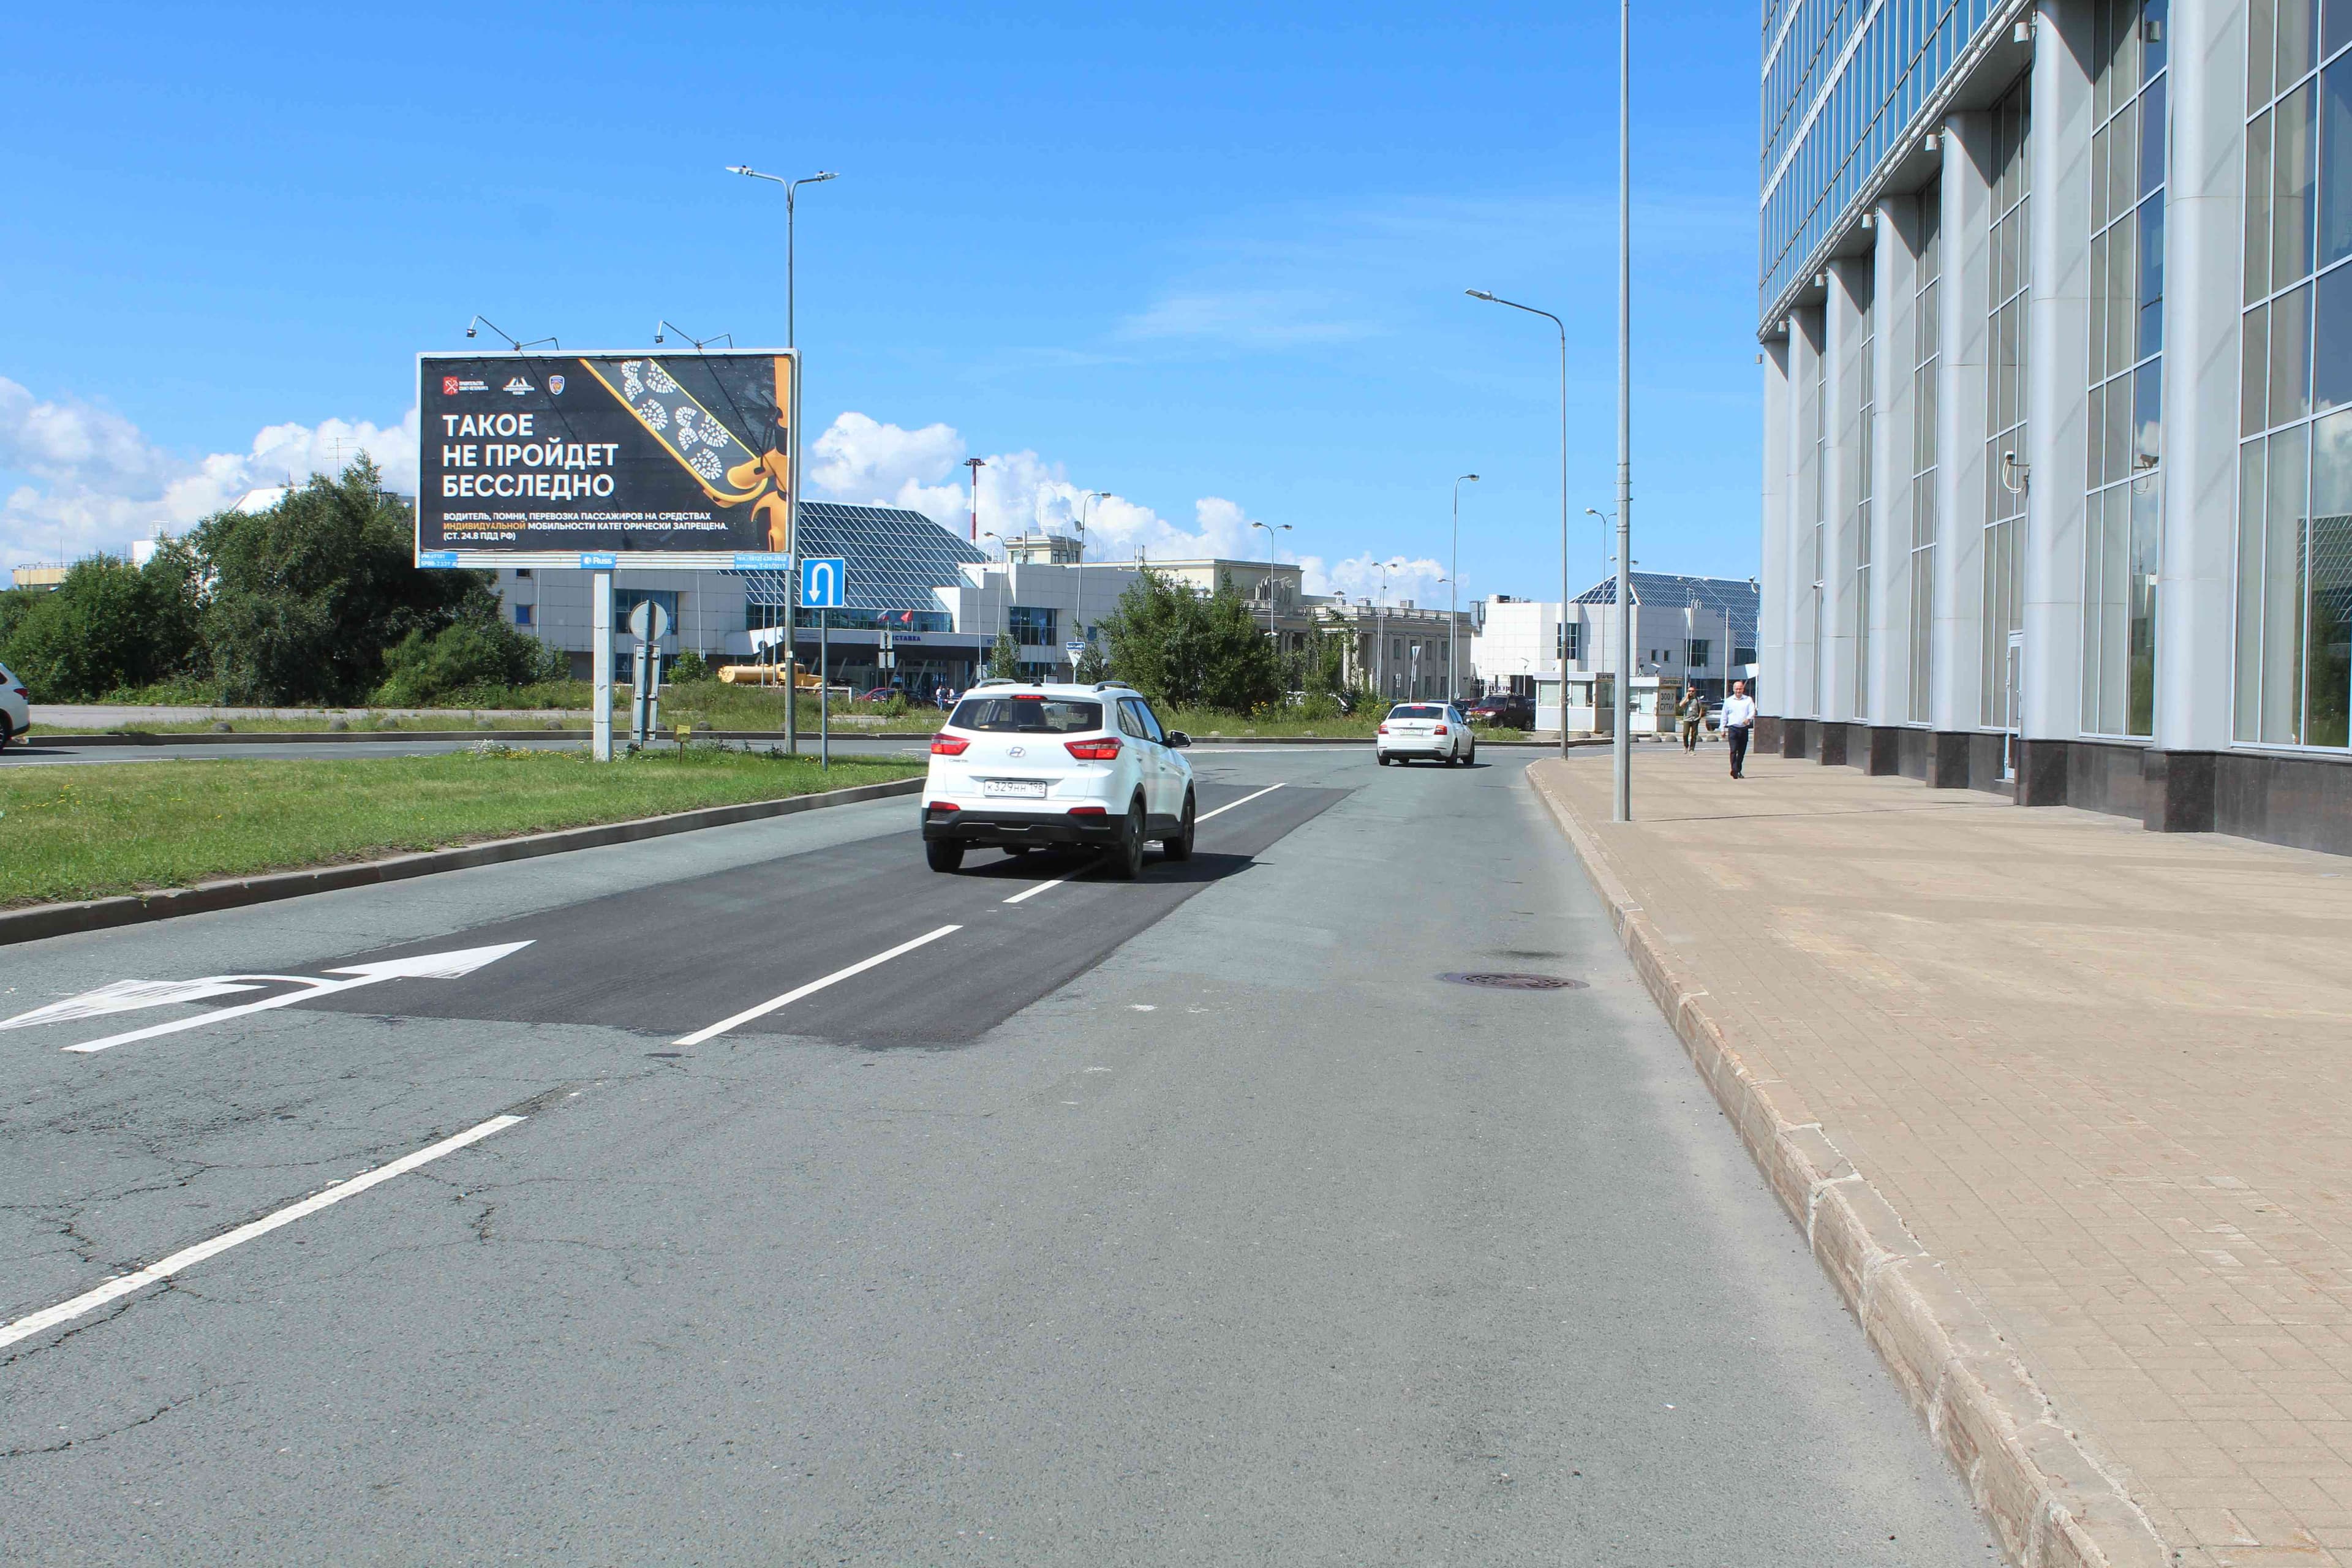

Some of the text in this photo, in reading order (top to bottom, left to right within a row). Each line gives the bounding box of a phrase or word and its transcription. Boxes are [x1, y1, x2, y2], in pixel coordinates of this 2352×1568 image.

[442, 413, 533, 437] ТАКОЕ
[443, 437, 619, 470] НЕ ПРОЙДЕТ
[443, 474, 614, 500] БЕССЛЕДНО
[443, 513, 491, 521] ВОДИТЕЛЬ,
[581, 512, 643, 521] ПАССАЖИРОВ
[659, 512, 710, 521] СРЕДСТВАХ
[443, 521, 526, 530] ИНДИВИДУАЛЬНОЙ
[673, 522, 728, 531] ЗАПРЕЩЕНА.
[443, 532, 459, 541] (СТ.
[500, 532, 516, 541] РФ)
